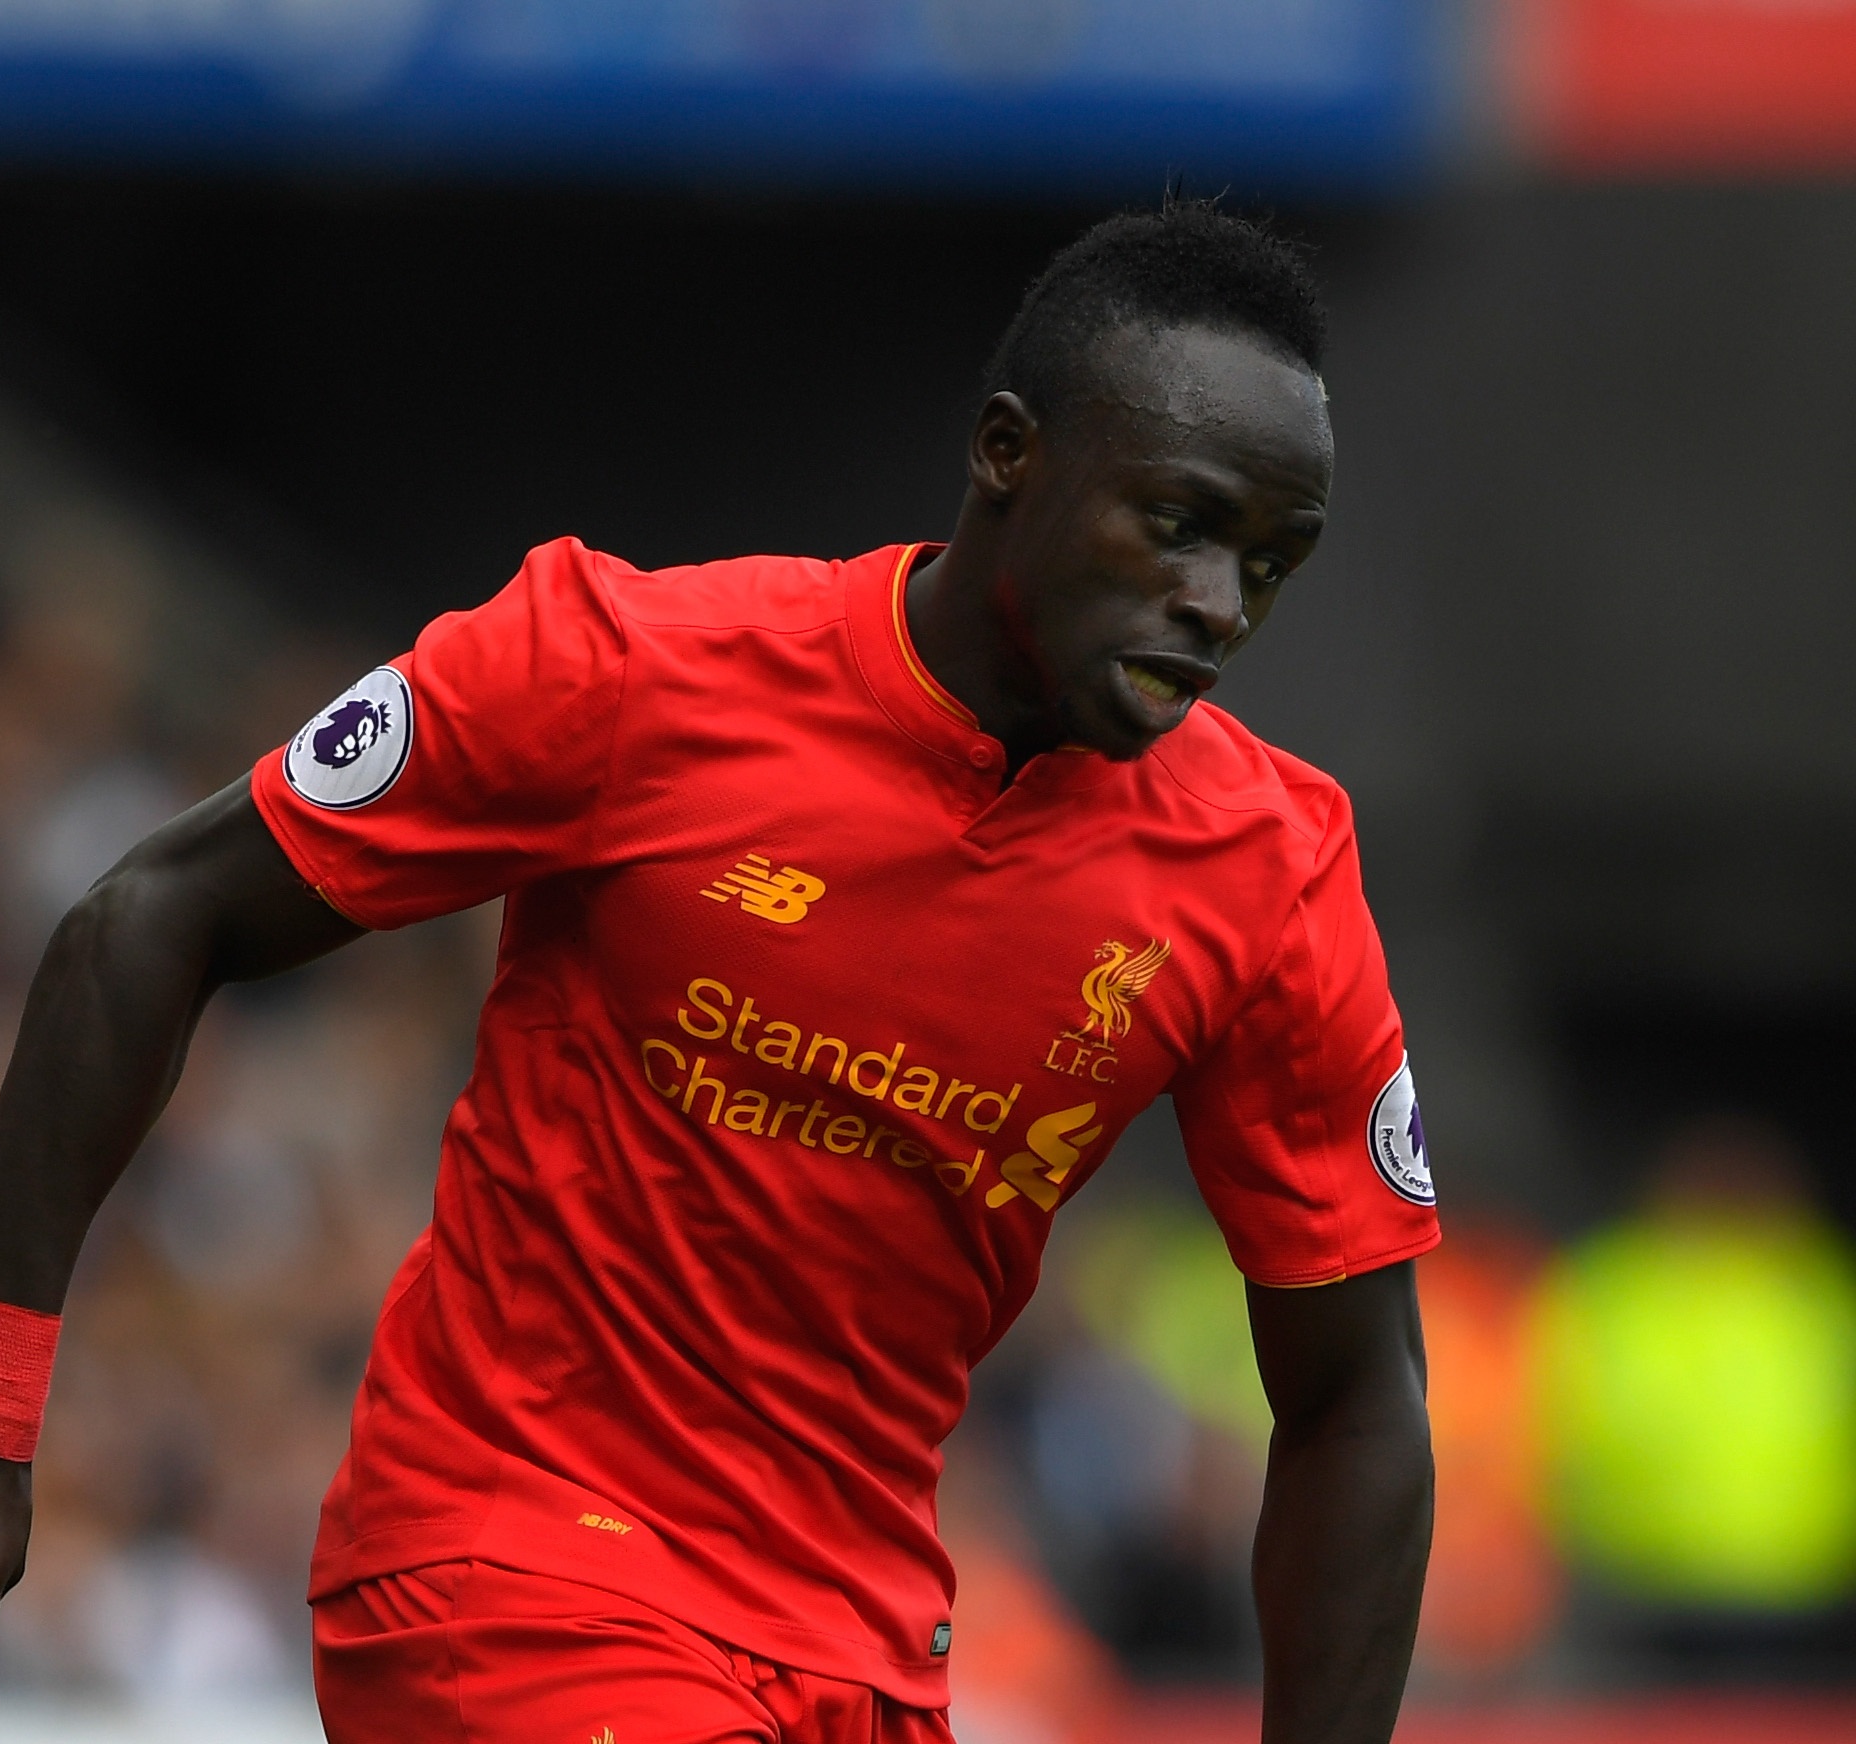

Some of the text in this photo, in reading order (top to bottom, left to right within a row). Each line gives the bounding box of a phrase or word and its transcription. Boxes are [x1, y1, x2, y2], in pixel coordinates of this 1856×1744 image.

[677, 977, 1022, 1134] Standard
[1044, 1039, 1119, 1084] L.F.C.
[640, 1038, 986, 1197] Chartered
[1382, 1128, 1404, 1172] Premier
[598, 1517, 633, 1535] DRY
